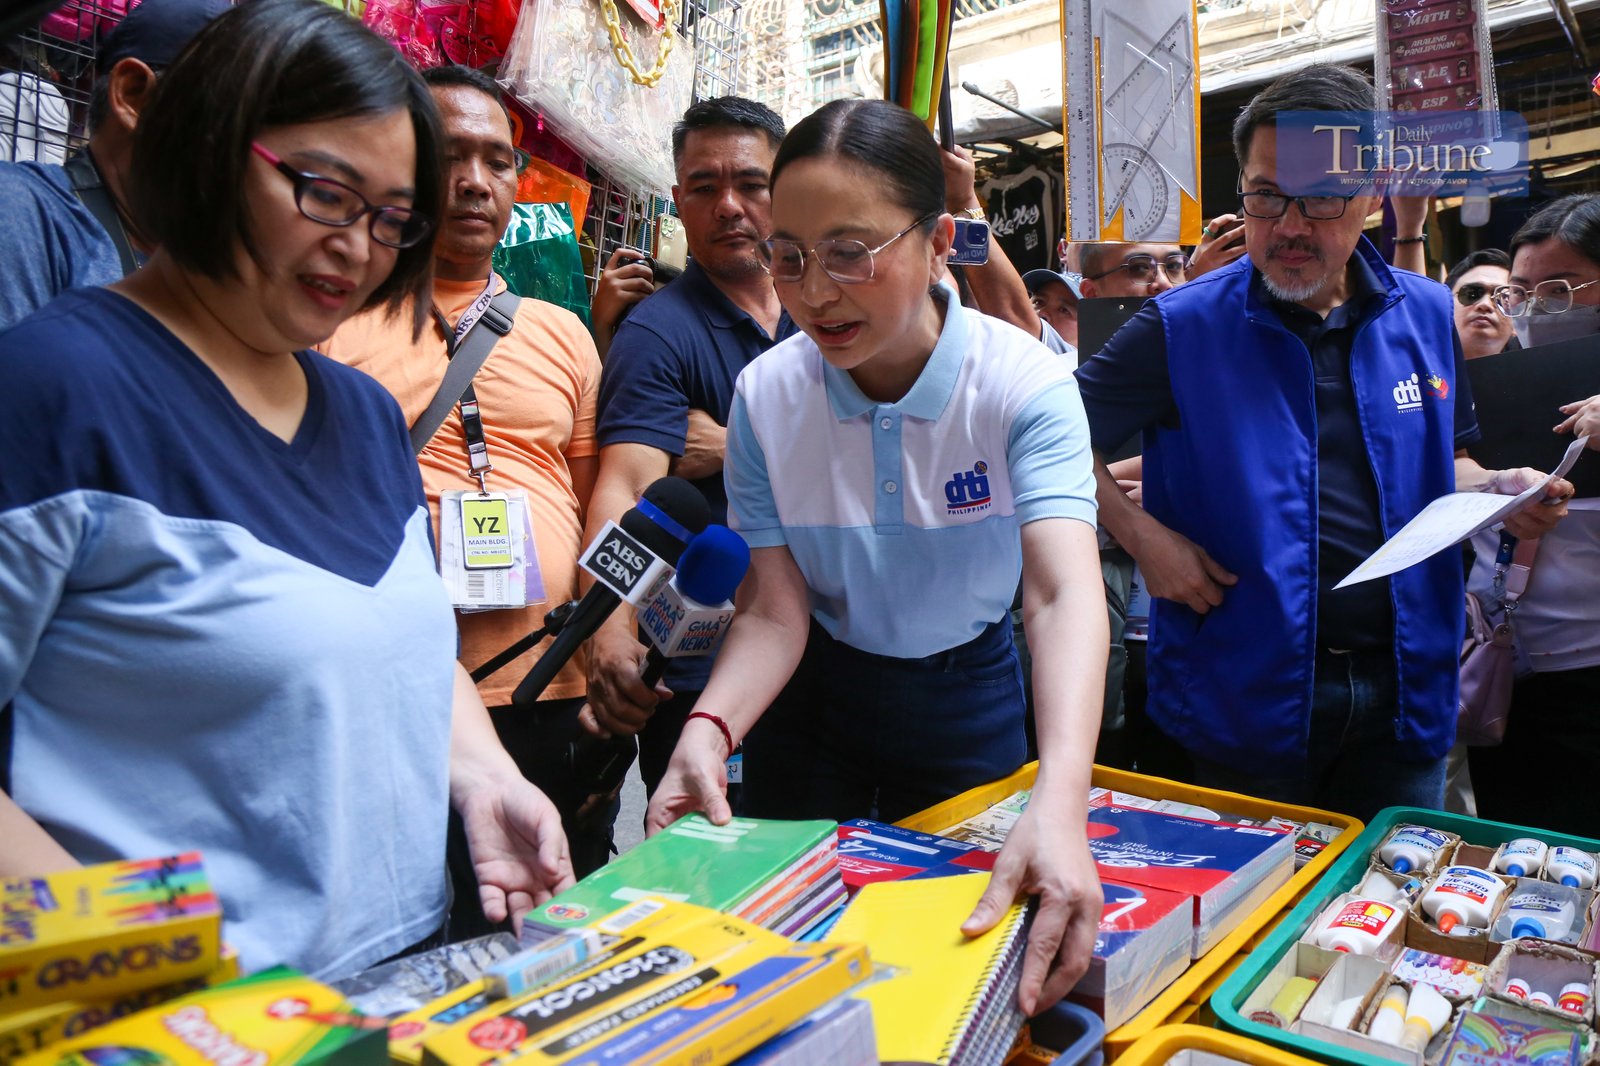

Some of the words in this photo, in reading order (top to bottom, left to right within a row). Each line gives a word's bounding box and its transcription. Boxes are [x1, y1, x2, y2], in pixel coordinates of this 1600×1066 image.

[1408, 10, 1450, 27] MATH
[1403, 41, 1456, 56] PANLIPUNAN
[1411, 34, 1447, 47] ARALING
[1421, 96, 1449, 109] ESP
[944, 460, 991, 504] dti
[472, 516, 501, 534] YZ
[604, 537, 646, 572] ABS
[596, 551, 637, 588] CBN
[643, 605, 670, 644] NEWS
[688, 620, 720, 632] GMA
[676, 636, 713, 652] NEWS
[37, 935, 203, 988] CRAYONS
[511, 947, 671, 1018] MONGOL
